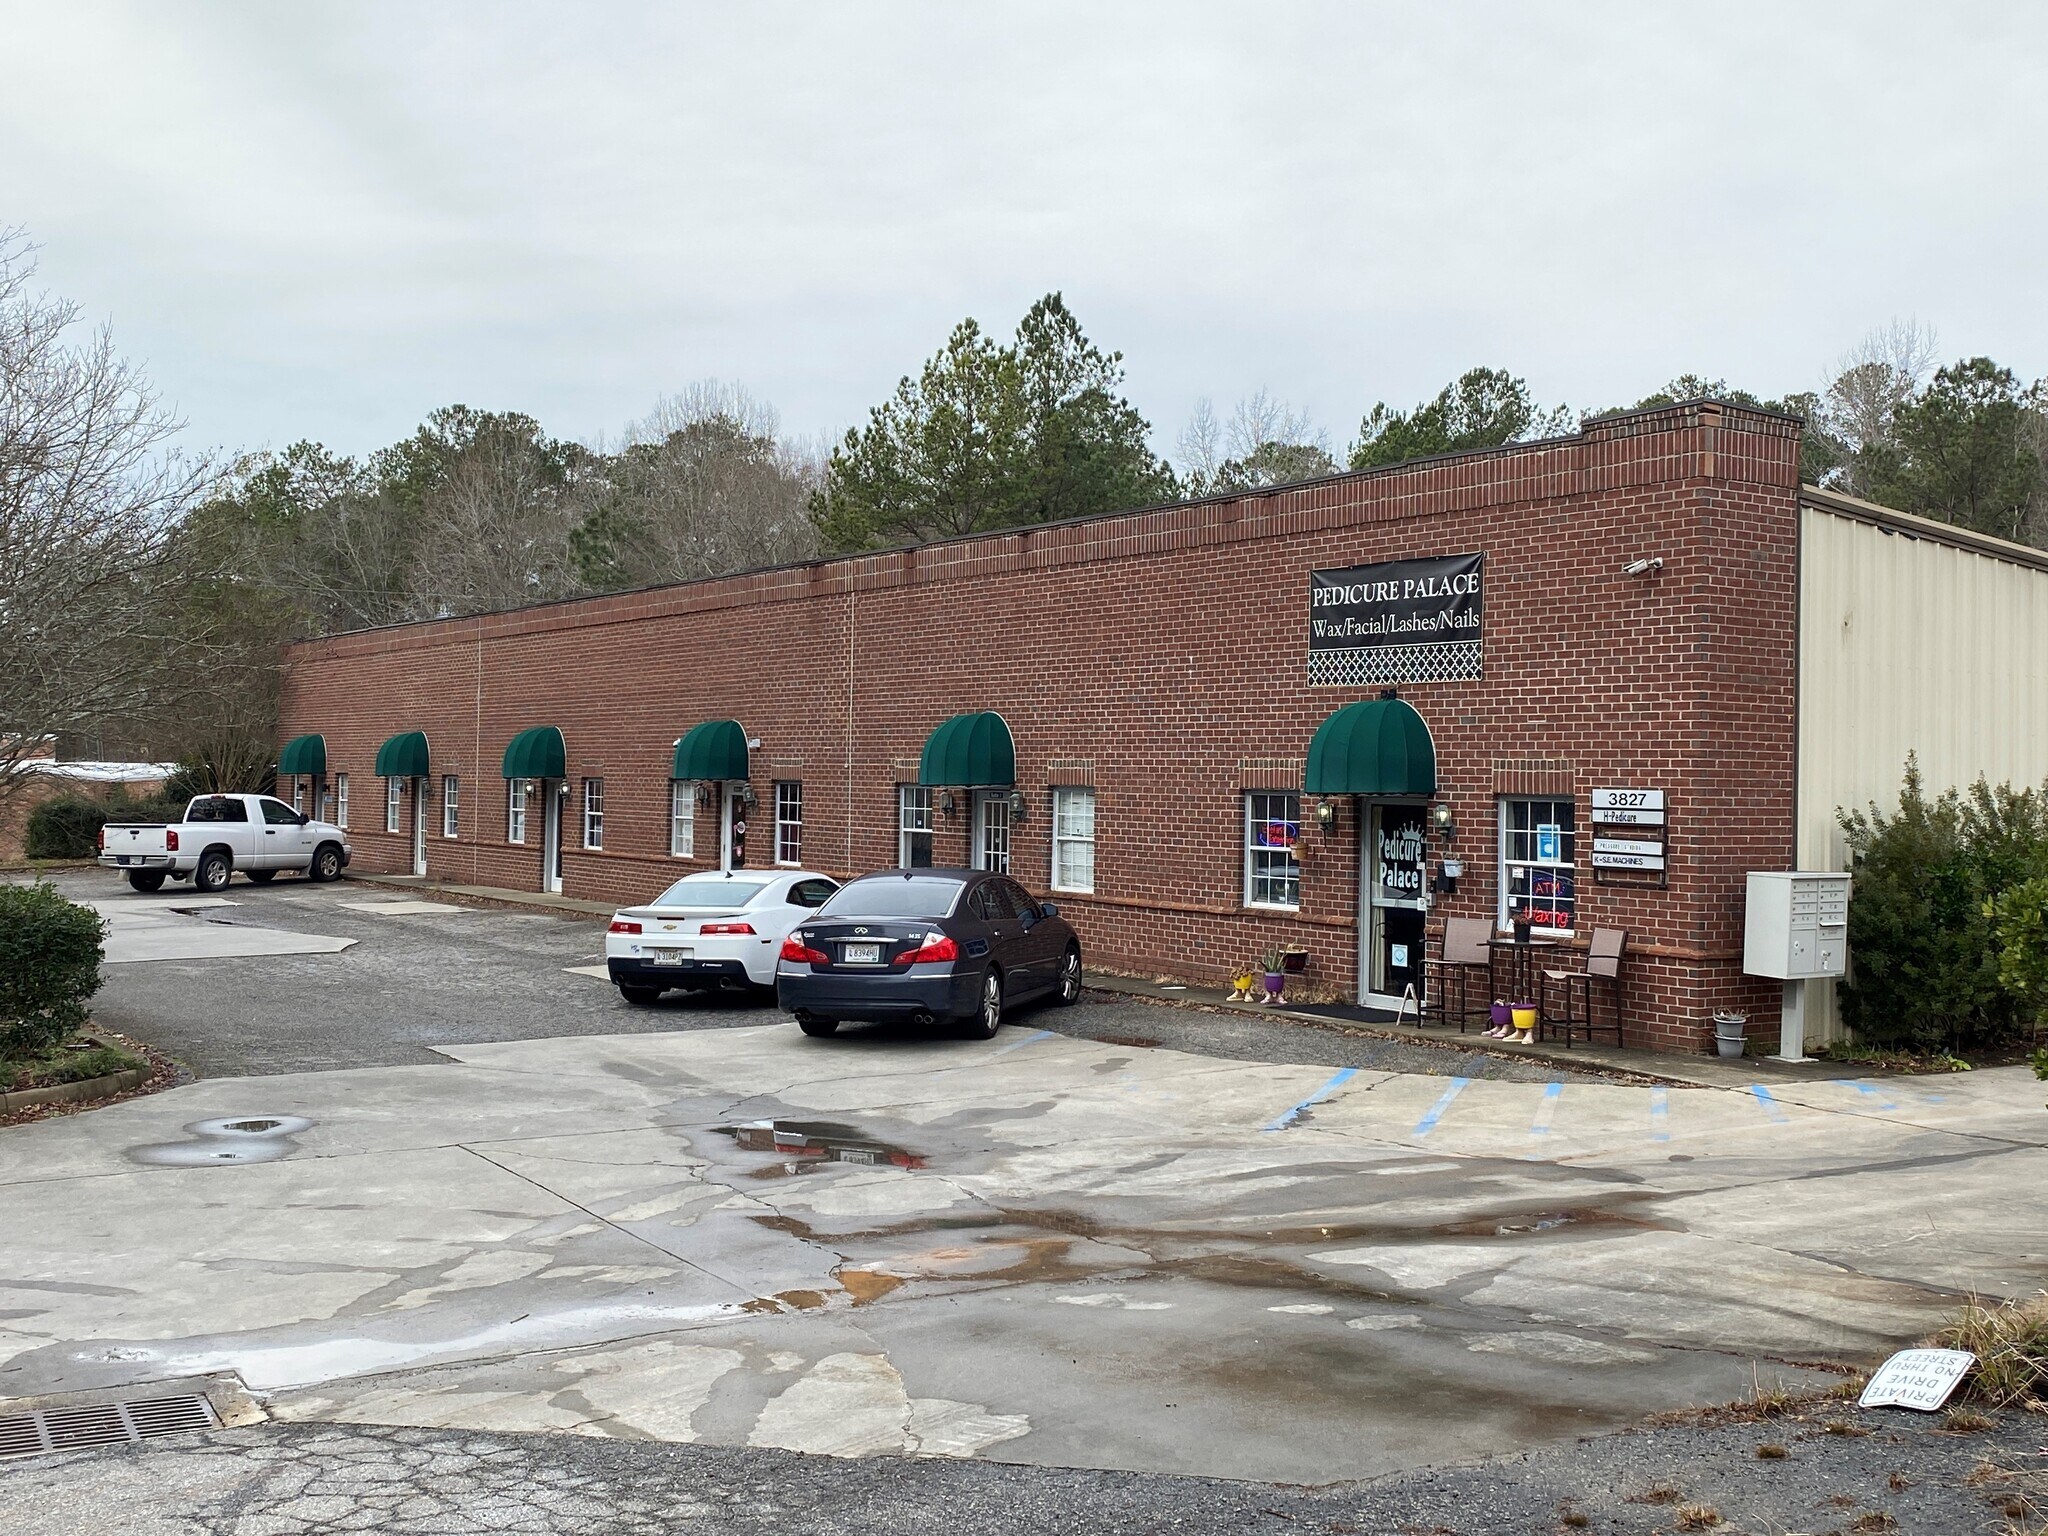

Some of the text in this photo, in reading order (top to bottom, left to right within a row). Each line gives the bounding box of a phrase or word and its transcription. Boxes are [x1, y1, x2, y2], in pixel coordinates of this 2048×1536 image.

[1312, 573, 1479, 607] PEDICURE PALACE
[1312, 607, 1480, 638] Wax/Facial/Lashes/Nails
[1608, 793, 1647, 806] 3827
[1378, 829, 1422, 861] Pedicure
[1379, 862, 1419, 889] Palace
[1535, 882, 1560, 894] ATM
[1903, 1354, 1958, 1366] STREET
[1890, 1361, 1956, 1377] NO THRU
[1886, 1374, 1940, 1389] DRIVE
[1868, 1387, 1939, 1403] PRIVATE
